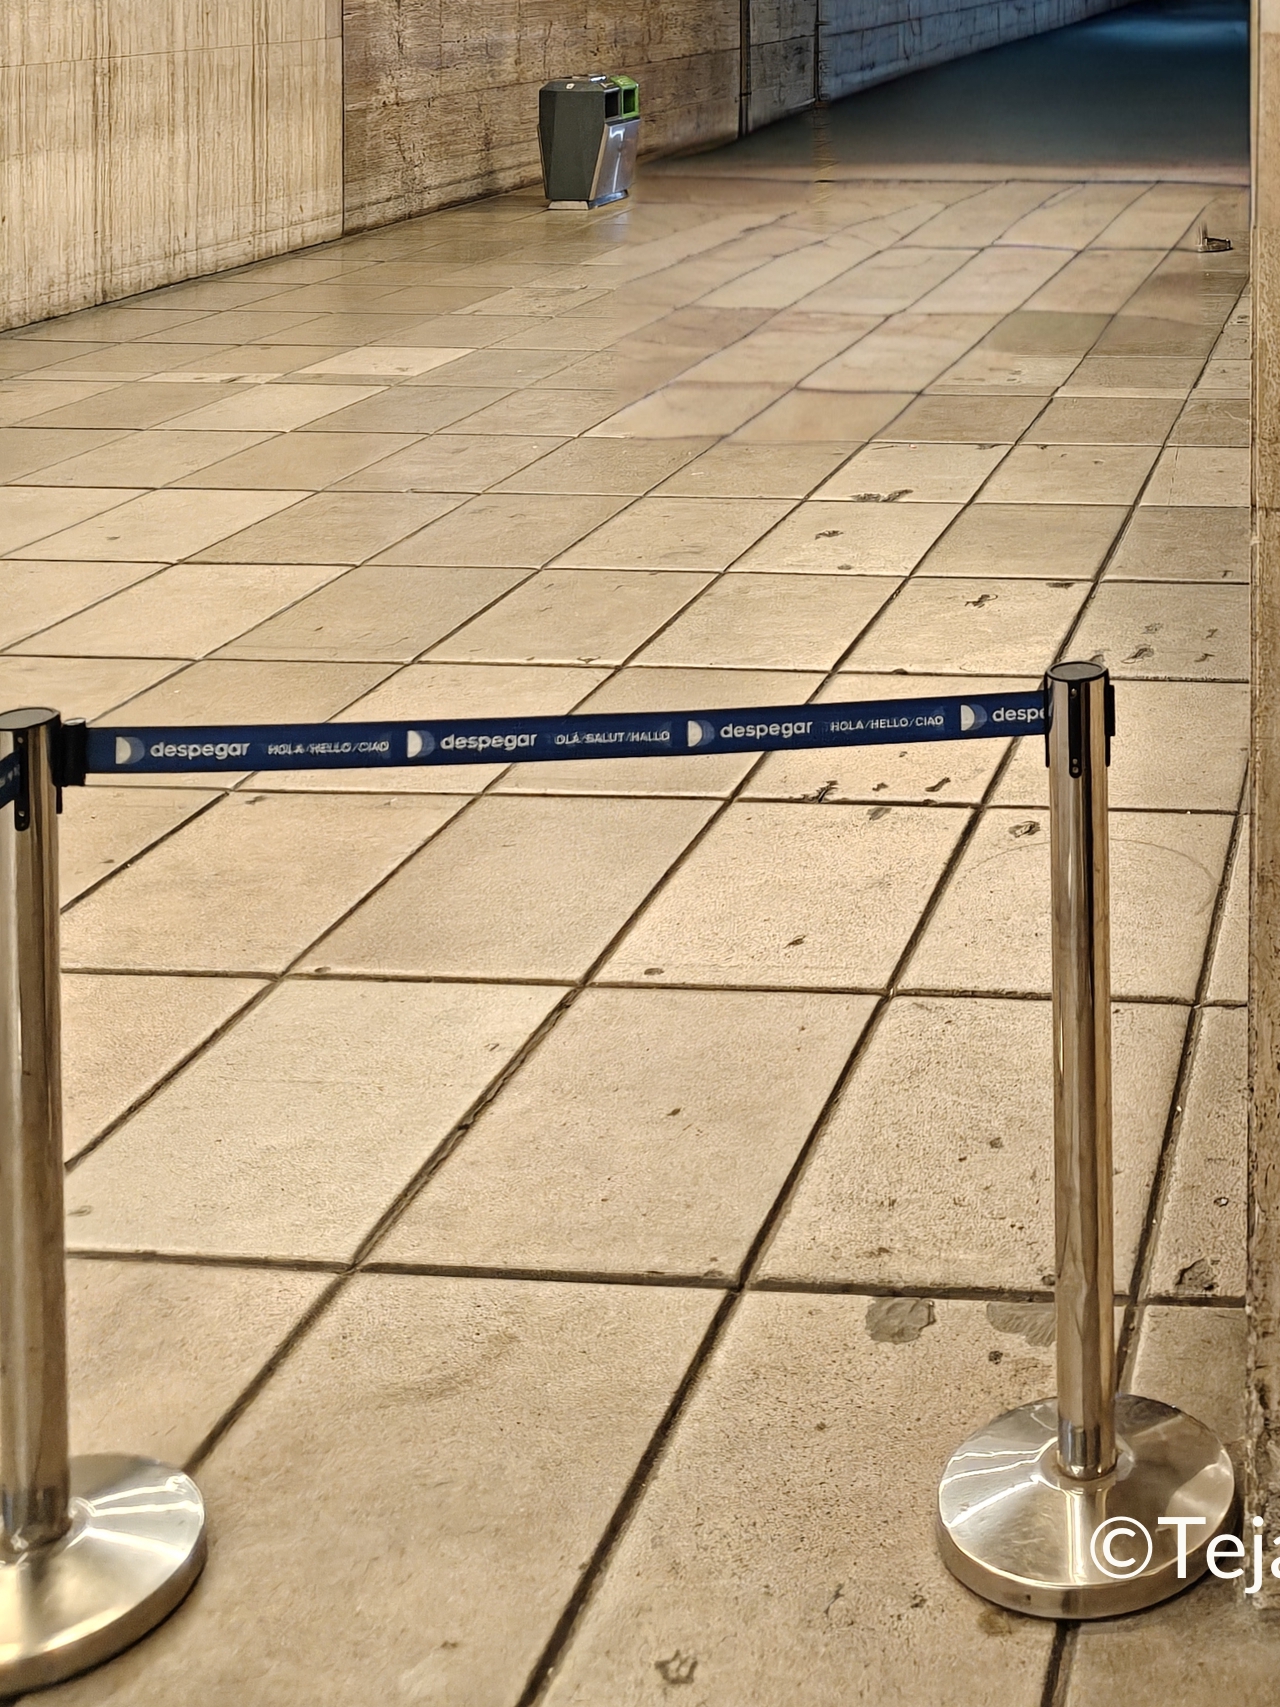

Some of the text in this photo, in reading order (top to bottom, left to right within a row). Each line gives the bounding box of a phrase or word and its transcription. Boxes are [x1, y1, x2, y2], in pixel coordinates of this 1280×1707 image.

[150, 740, 250, 762] despegar
[440, 731, 538, 751] despegar
[720, 719, 813, 740] despegar
[830, 715, 944, 732] HOLA/HELLO/CIAO
